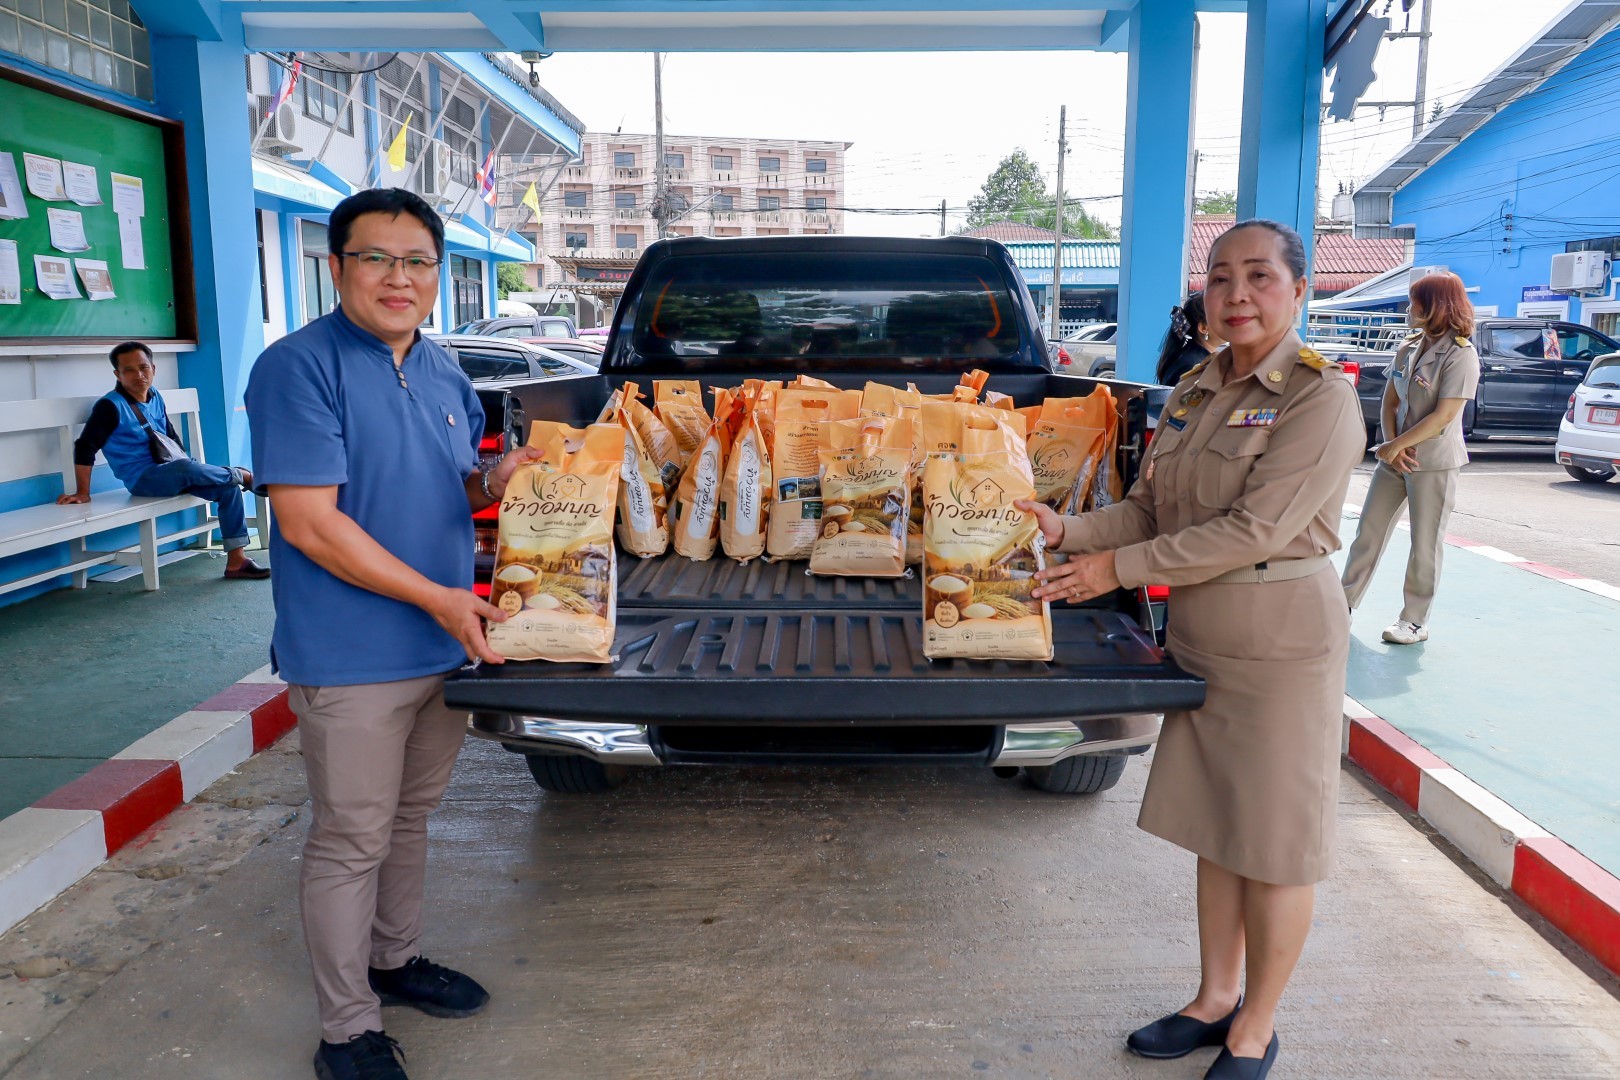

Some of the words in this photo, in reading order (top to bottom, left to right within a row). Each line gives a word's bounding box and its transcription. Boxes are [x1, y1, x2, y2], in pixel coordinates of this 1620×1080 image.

[502, 490, 601, 519] ข้าวอิ่มบุญ
[926, 494, 1022, 527] ข้าวอิ่มบุญ
